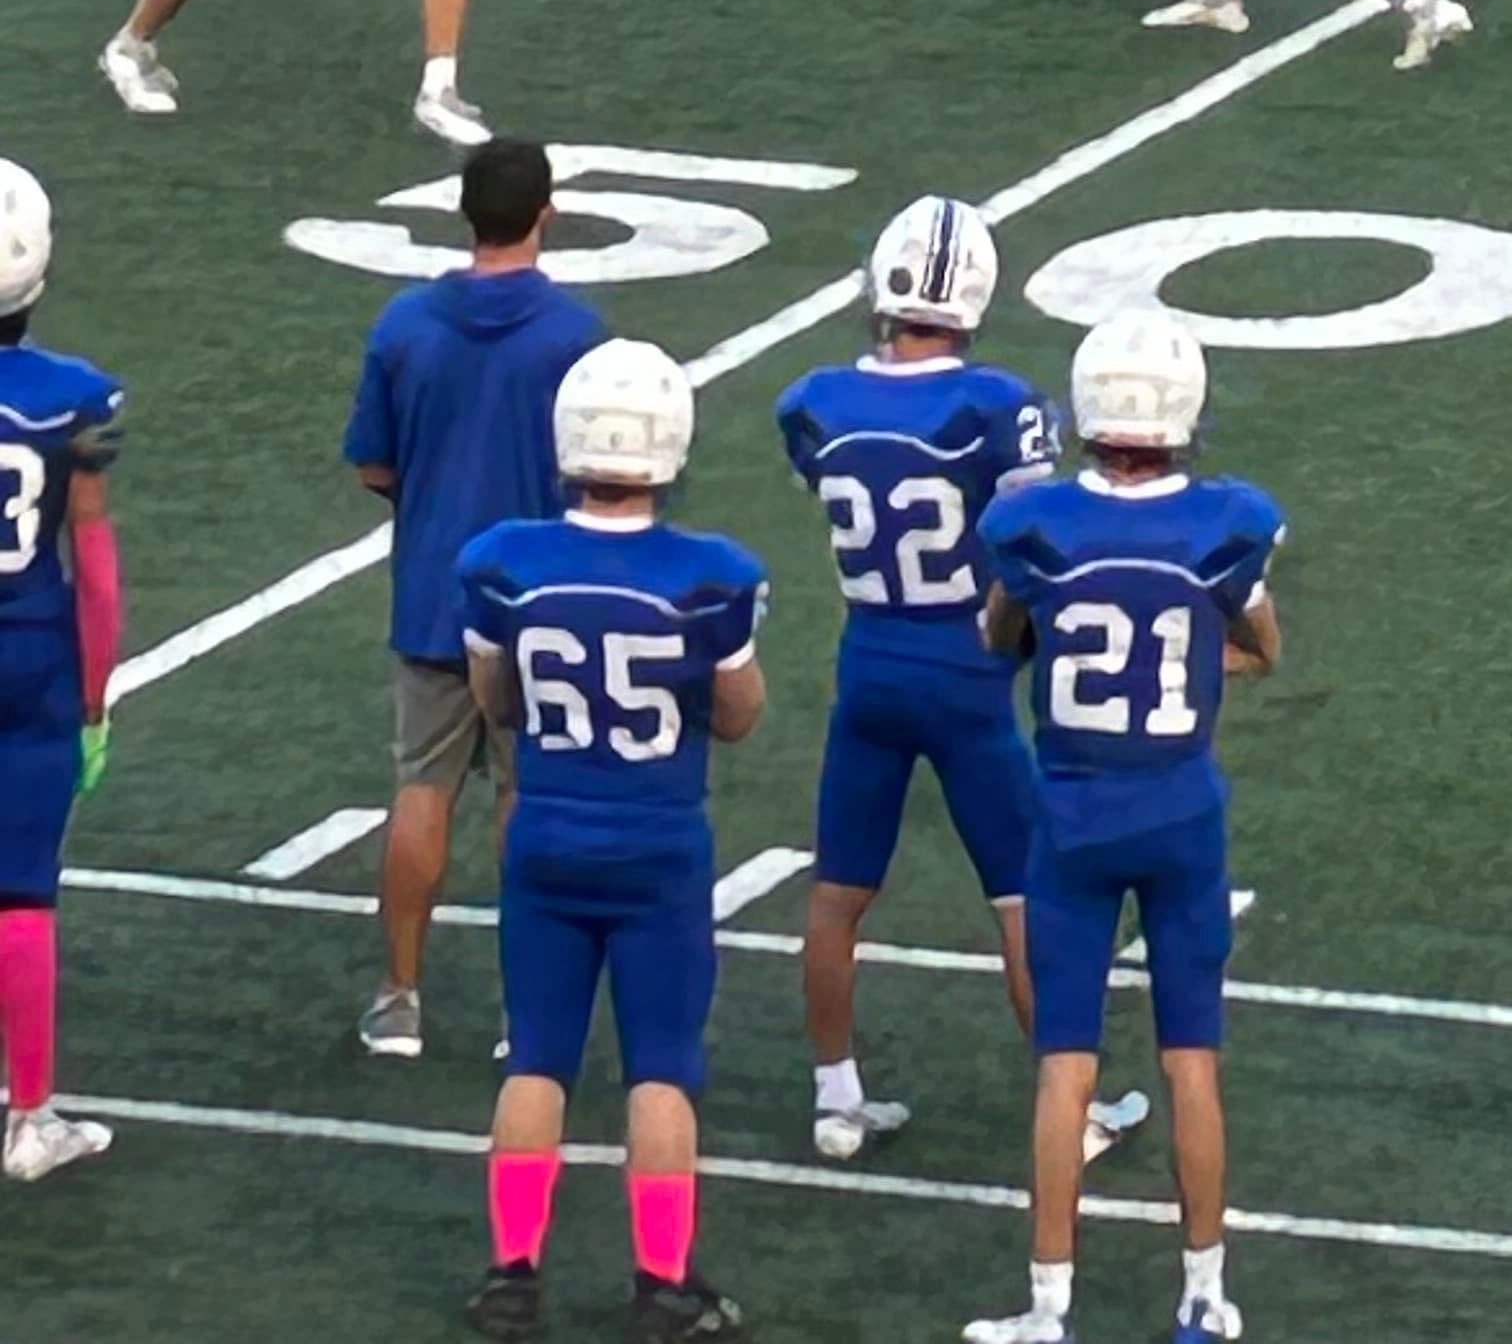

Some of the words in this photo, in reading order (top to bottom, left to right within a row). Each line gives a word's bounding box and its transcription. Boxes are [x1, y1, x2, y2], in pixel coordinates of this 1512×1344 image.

[817, 475, 978, 605] 22
[517, 626, 686, 761] 65
[1050, 603, 1198, 735] 21
